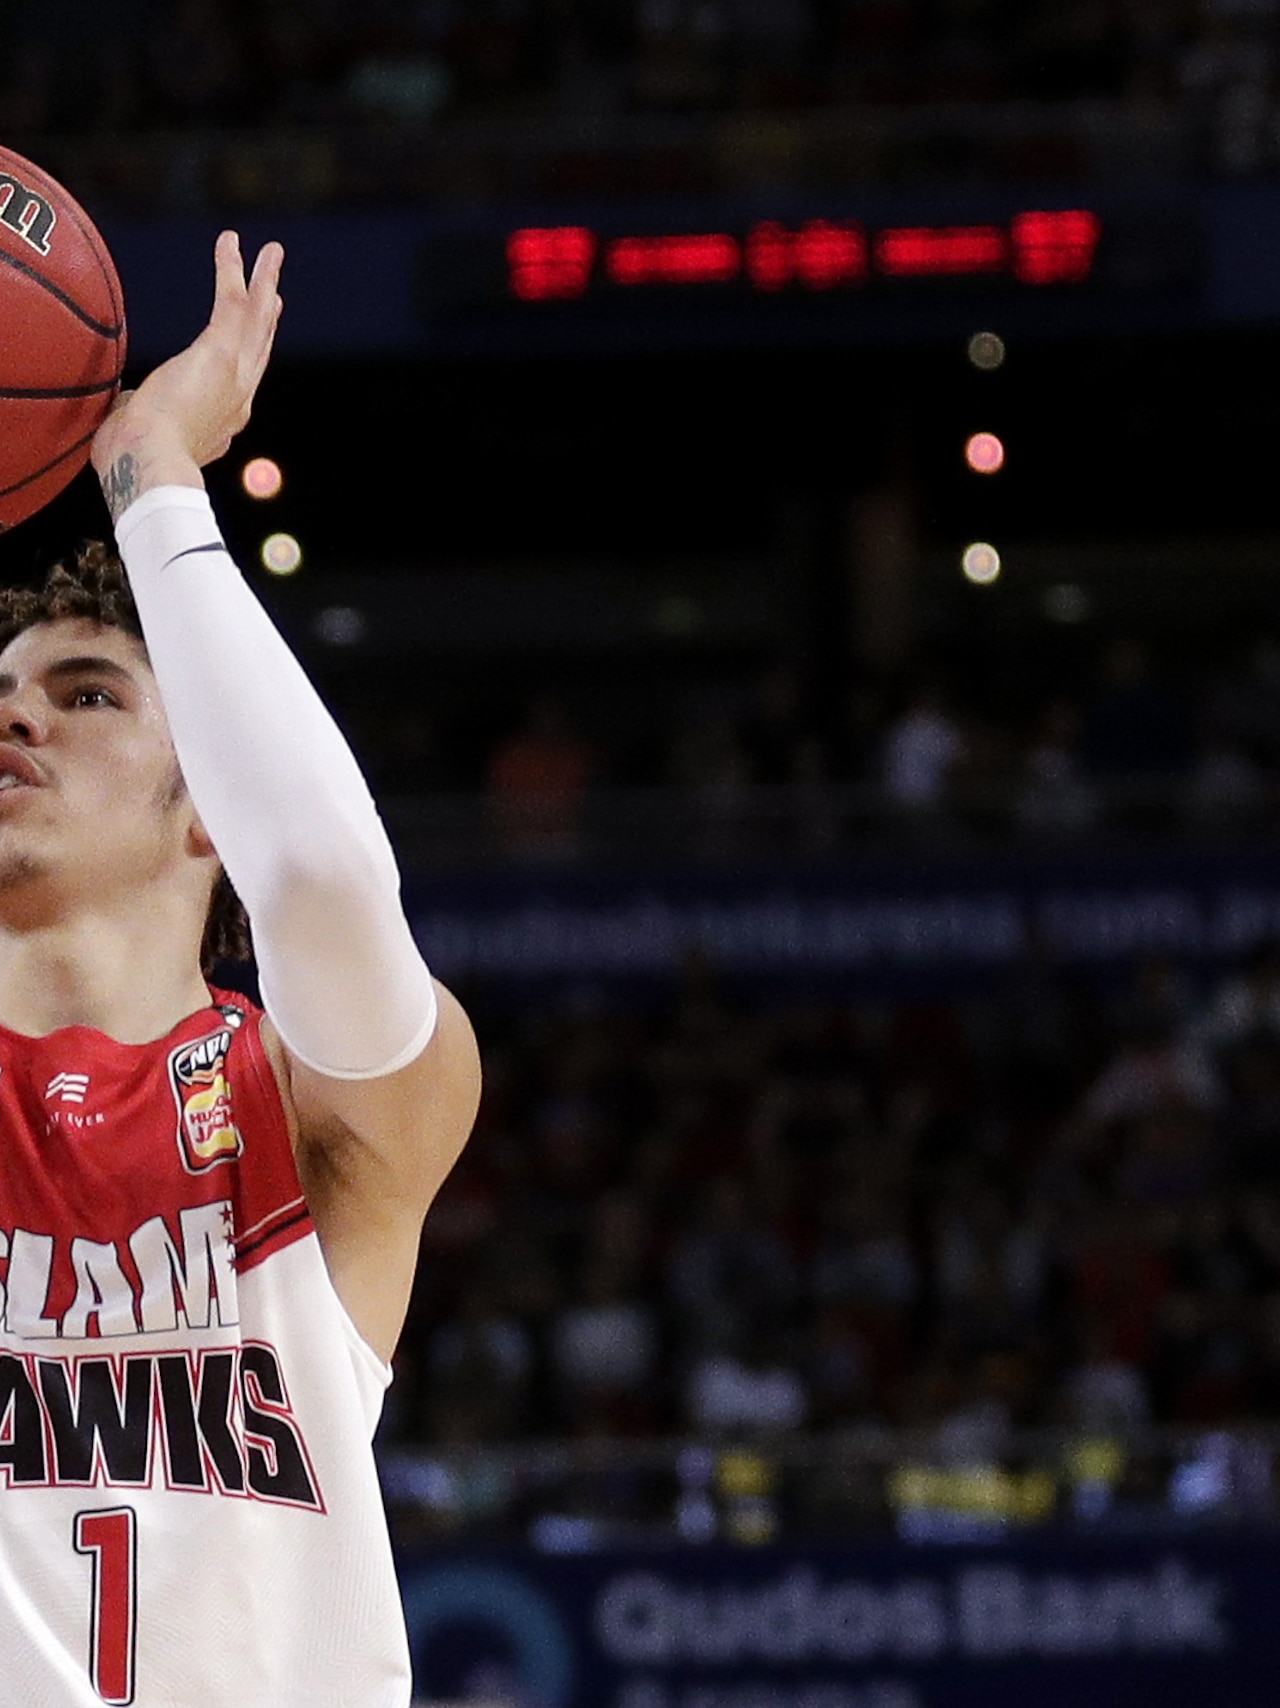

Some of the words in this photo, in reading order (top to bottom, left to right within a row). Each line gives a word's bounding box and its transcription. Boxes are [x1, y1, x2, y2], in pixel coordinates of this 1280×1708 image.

[73, 1504, 137, 1707] 1
[600, 1566, 944, 1653] Qudos
[957, 1558, 1226, 1650] Bank
